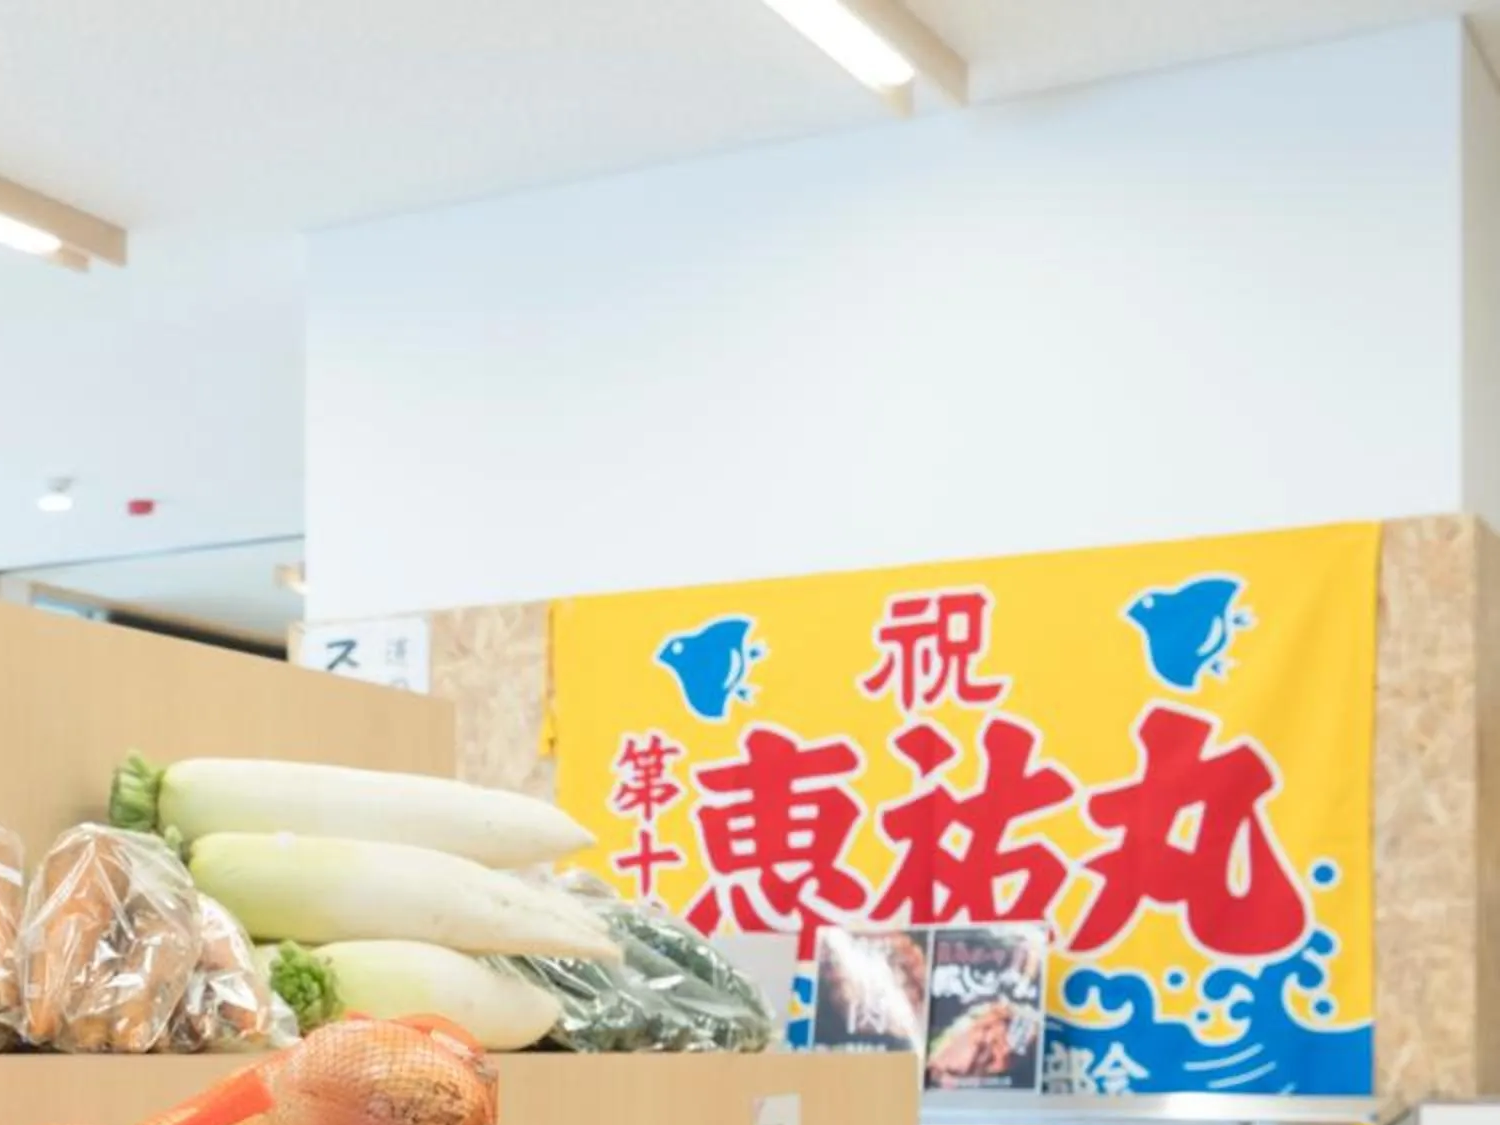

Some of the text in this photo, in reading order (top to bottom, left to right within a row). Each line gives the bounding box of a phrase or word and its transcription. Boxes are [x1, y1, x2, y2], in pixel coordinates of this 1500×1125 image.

[864, 592, 1006, 708] 祝
[686, 706, 1307, 960] 恵祐丸
